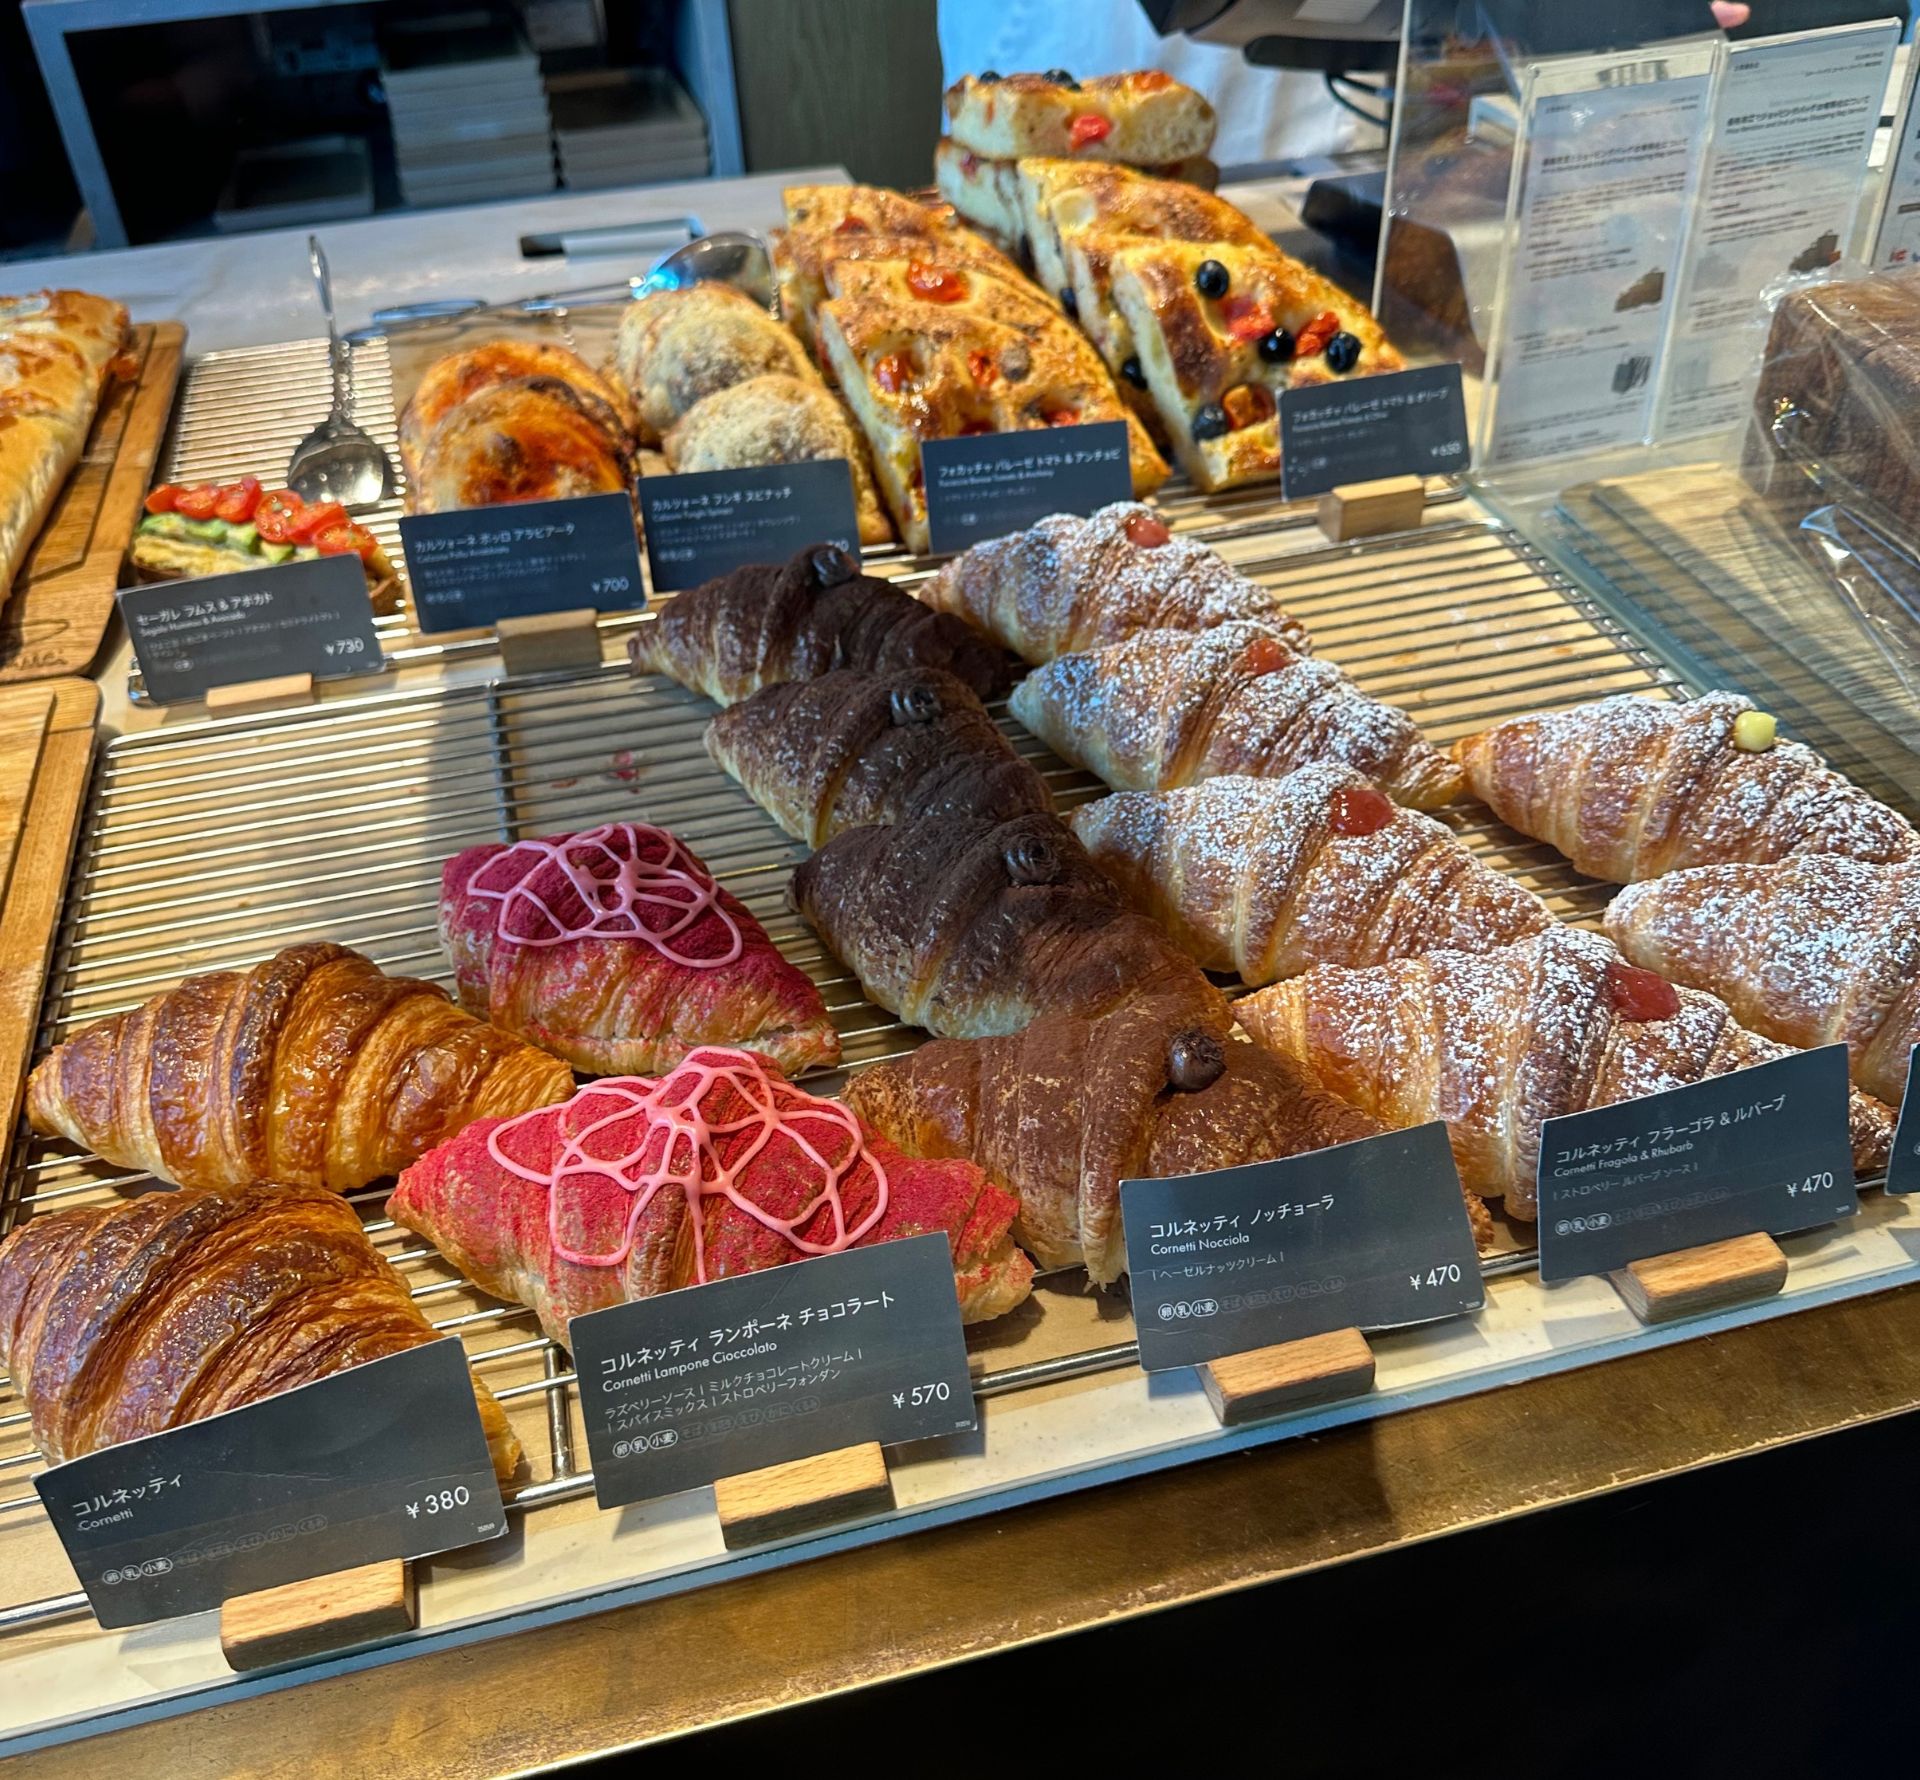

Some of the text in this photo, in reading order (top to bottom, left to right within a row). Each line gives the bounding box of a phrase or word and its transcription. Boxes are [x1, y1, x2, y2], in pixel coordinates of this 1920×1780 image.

[1556, 1094, 1786, 1163] コルネッティ フラーゴラ & ルバーブ
[1554, 1161, 1597, 1178] Cornetti
[1598, 1153, 1638, 1169] Fragola
[1651, 1140, 1694, 1158] Rhubarb
[1150, 1194, 1335, 1239] コルネッティ ノッチョーラ
[1150, 1233, 1250, 1255] Cornetti Nocciola
[601, 1291, 895, 1375] コルネッティ ランポーネ チョコラート
[602, 1342, 778, 1393] Cornetti Lampone Cioccolato
[72, 1474, 182, 1517] コルネッティ
[78, 1508, 134, 1531] Cornetti
